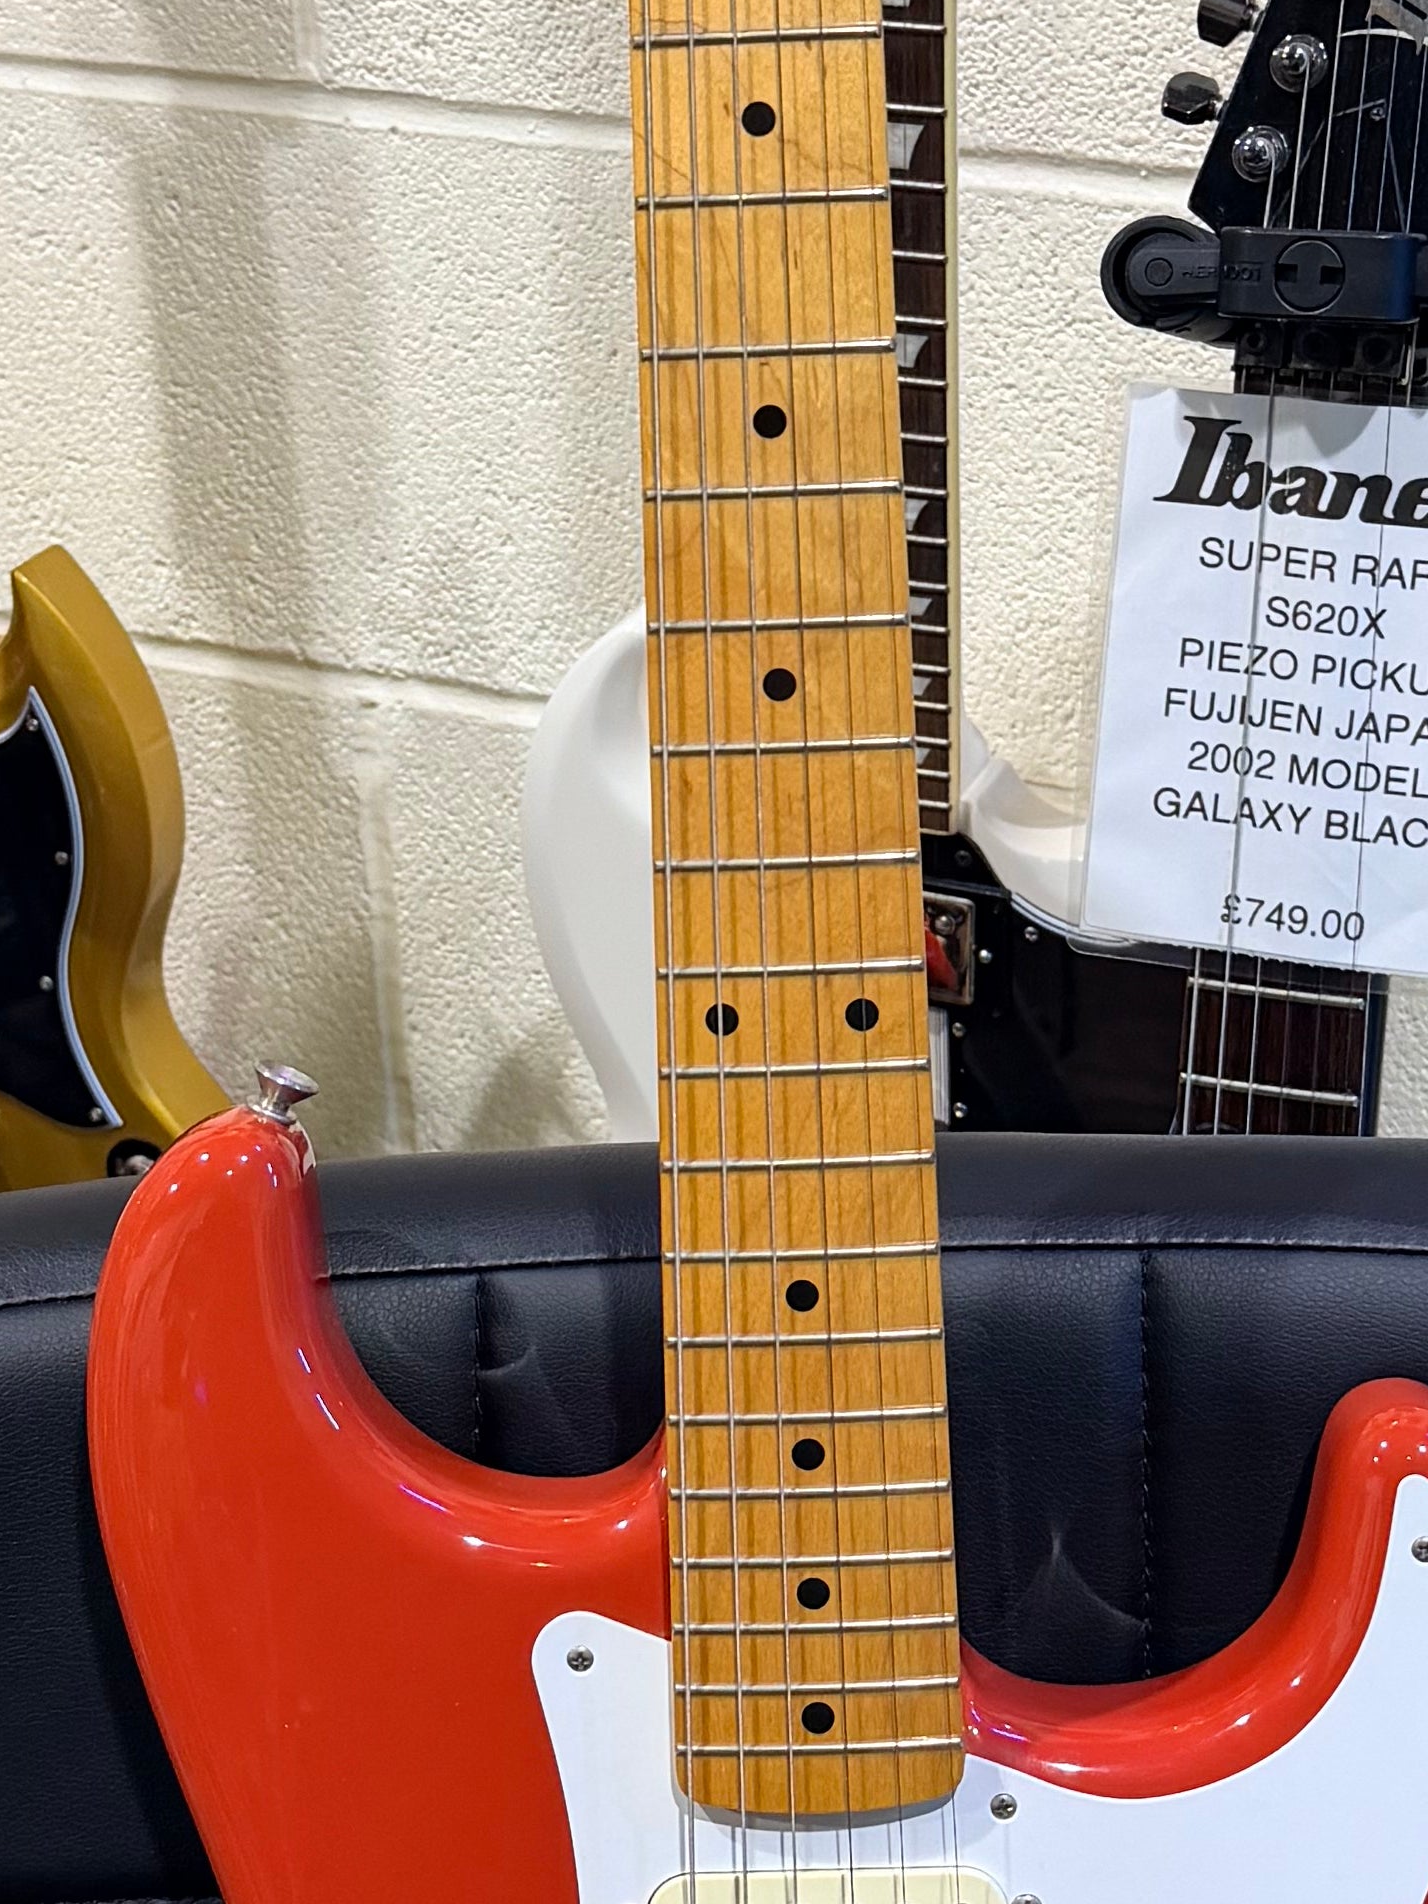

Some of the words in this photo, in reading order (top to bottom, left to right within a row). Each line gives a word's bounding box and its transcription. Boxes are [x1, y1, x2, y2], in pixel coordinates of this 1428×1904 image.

[1199, 536, 1338, 586] SUPER
[1265, 596, 1388, 640] S620X
[1179, 637, 1299, 681] PIEZO
[1164, 687, 1323, 737] FUJIJEN
[1187, 741, 1276, 781] 2002
[1153, 787, 1312, 836] GALAXY
[1221, 894, 1366, 942] £749.00
